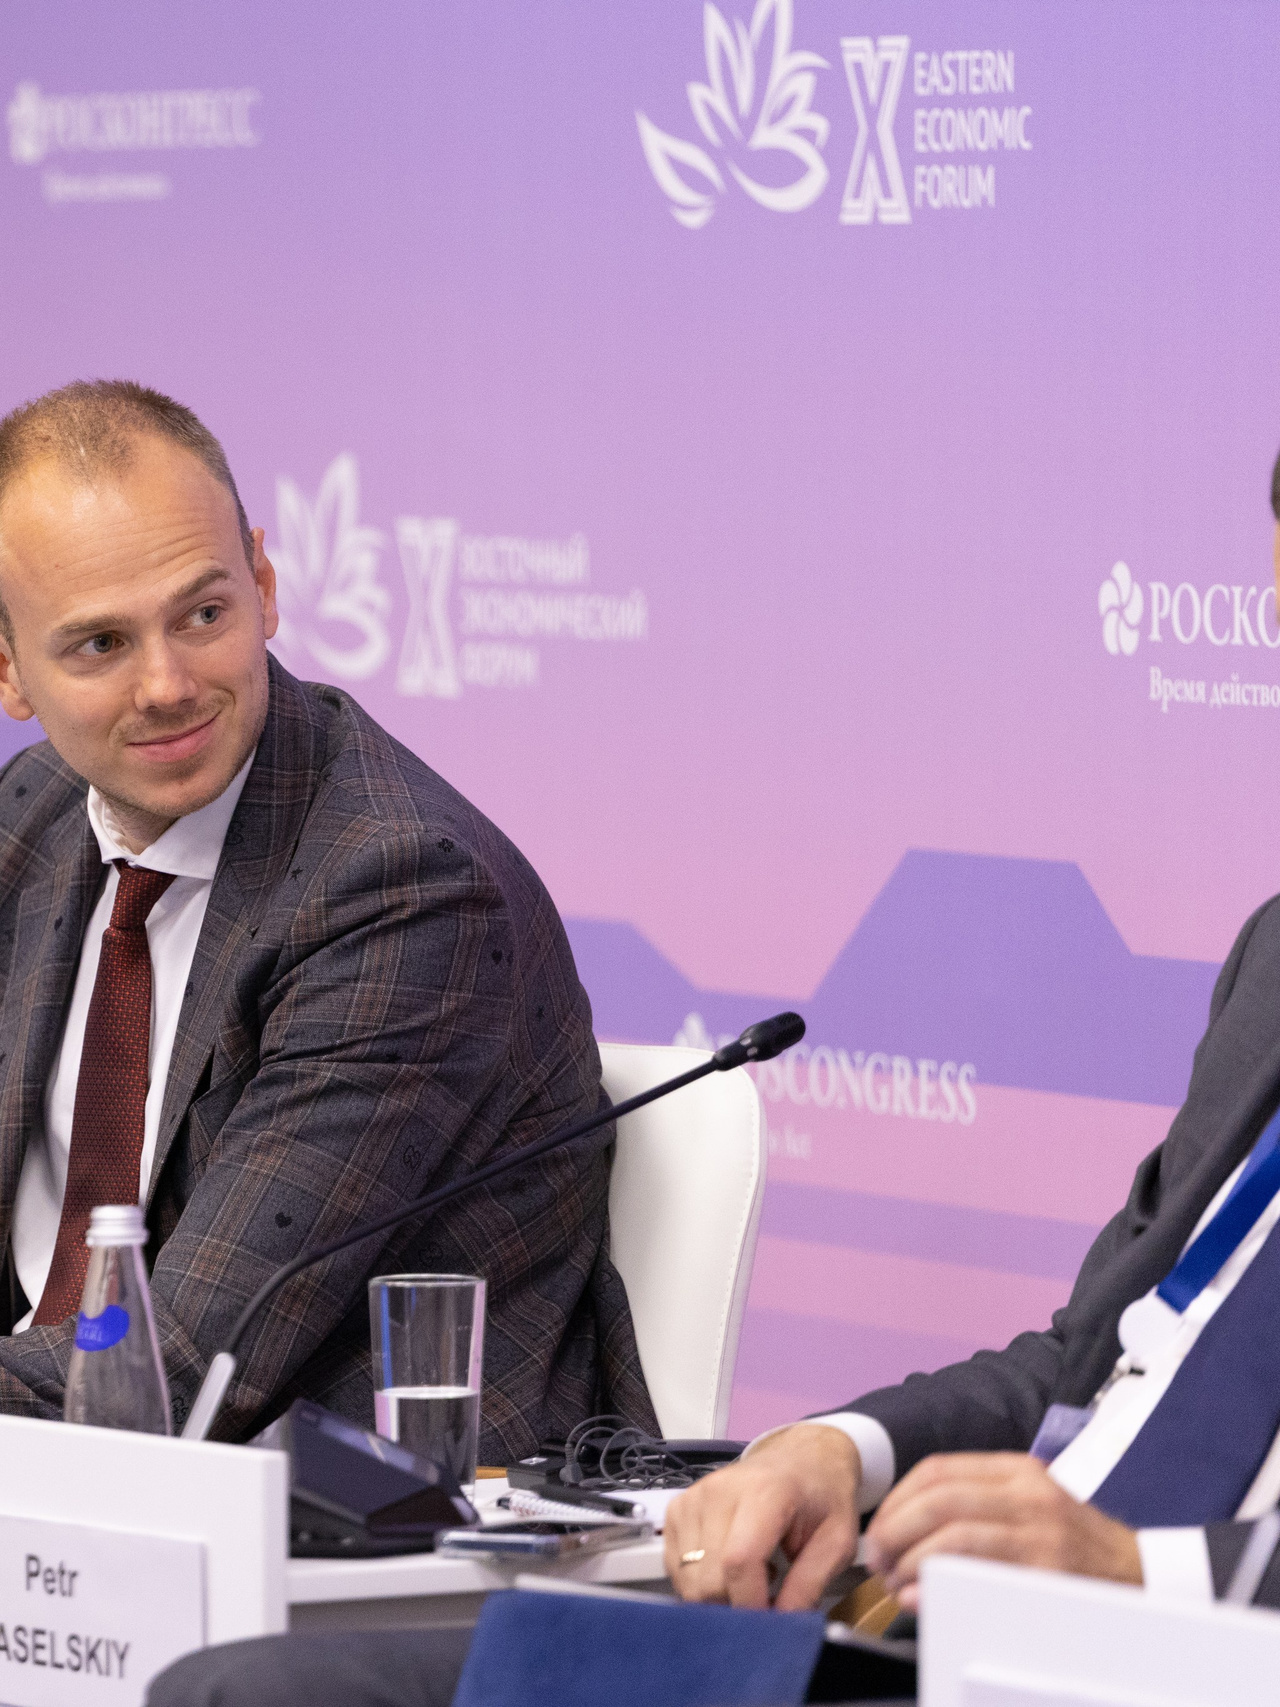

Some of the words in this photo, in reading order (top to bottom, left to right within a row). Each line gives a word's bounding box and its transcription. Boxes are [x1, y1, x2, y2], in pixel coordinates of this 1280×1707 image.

[914, 50, 1015, 96] EASTERN
[914, 106, 1033, 153] ECONOMIC
[914, 164, 996, 209] FORUM
[1149, 666, 1206, 713] Время
[754, 1043, 977, 1126] SCONGRESS
[25, 1554, 79, 1597] Petr
